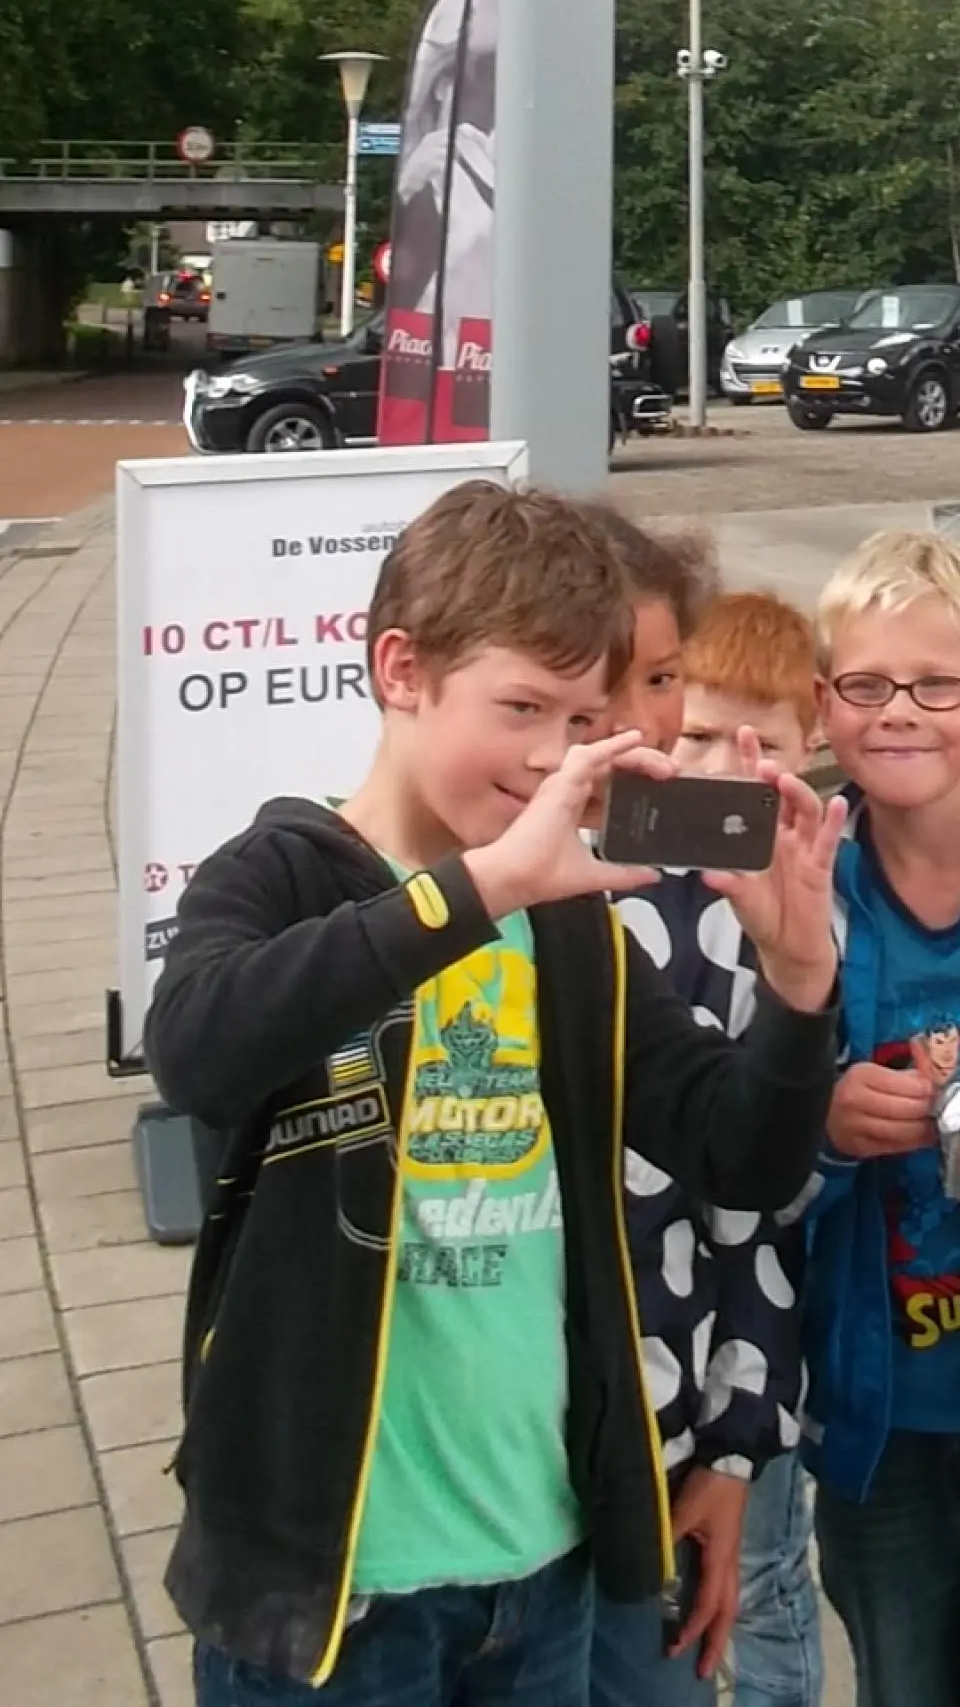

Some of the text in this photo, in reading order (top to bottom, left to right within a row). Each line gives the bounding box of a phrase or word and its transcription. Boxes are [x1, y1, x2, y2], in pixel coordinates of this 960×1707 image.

[272, 538, 301, 557] De
[144, 625, 185, 655] 10
[204, 618, 298, 651] CT/L
[179, 662, 368, 712] OP EUR
[409, 1093, 543, 1132] MOTOR
